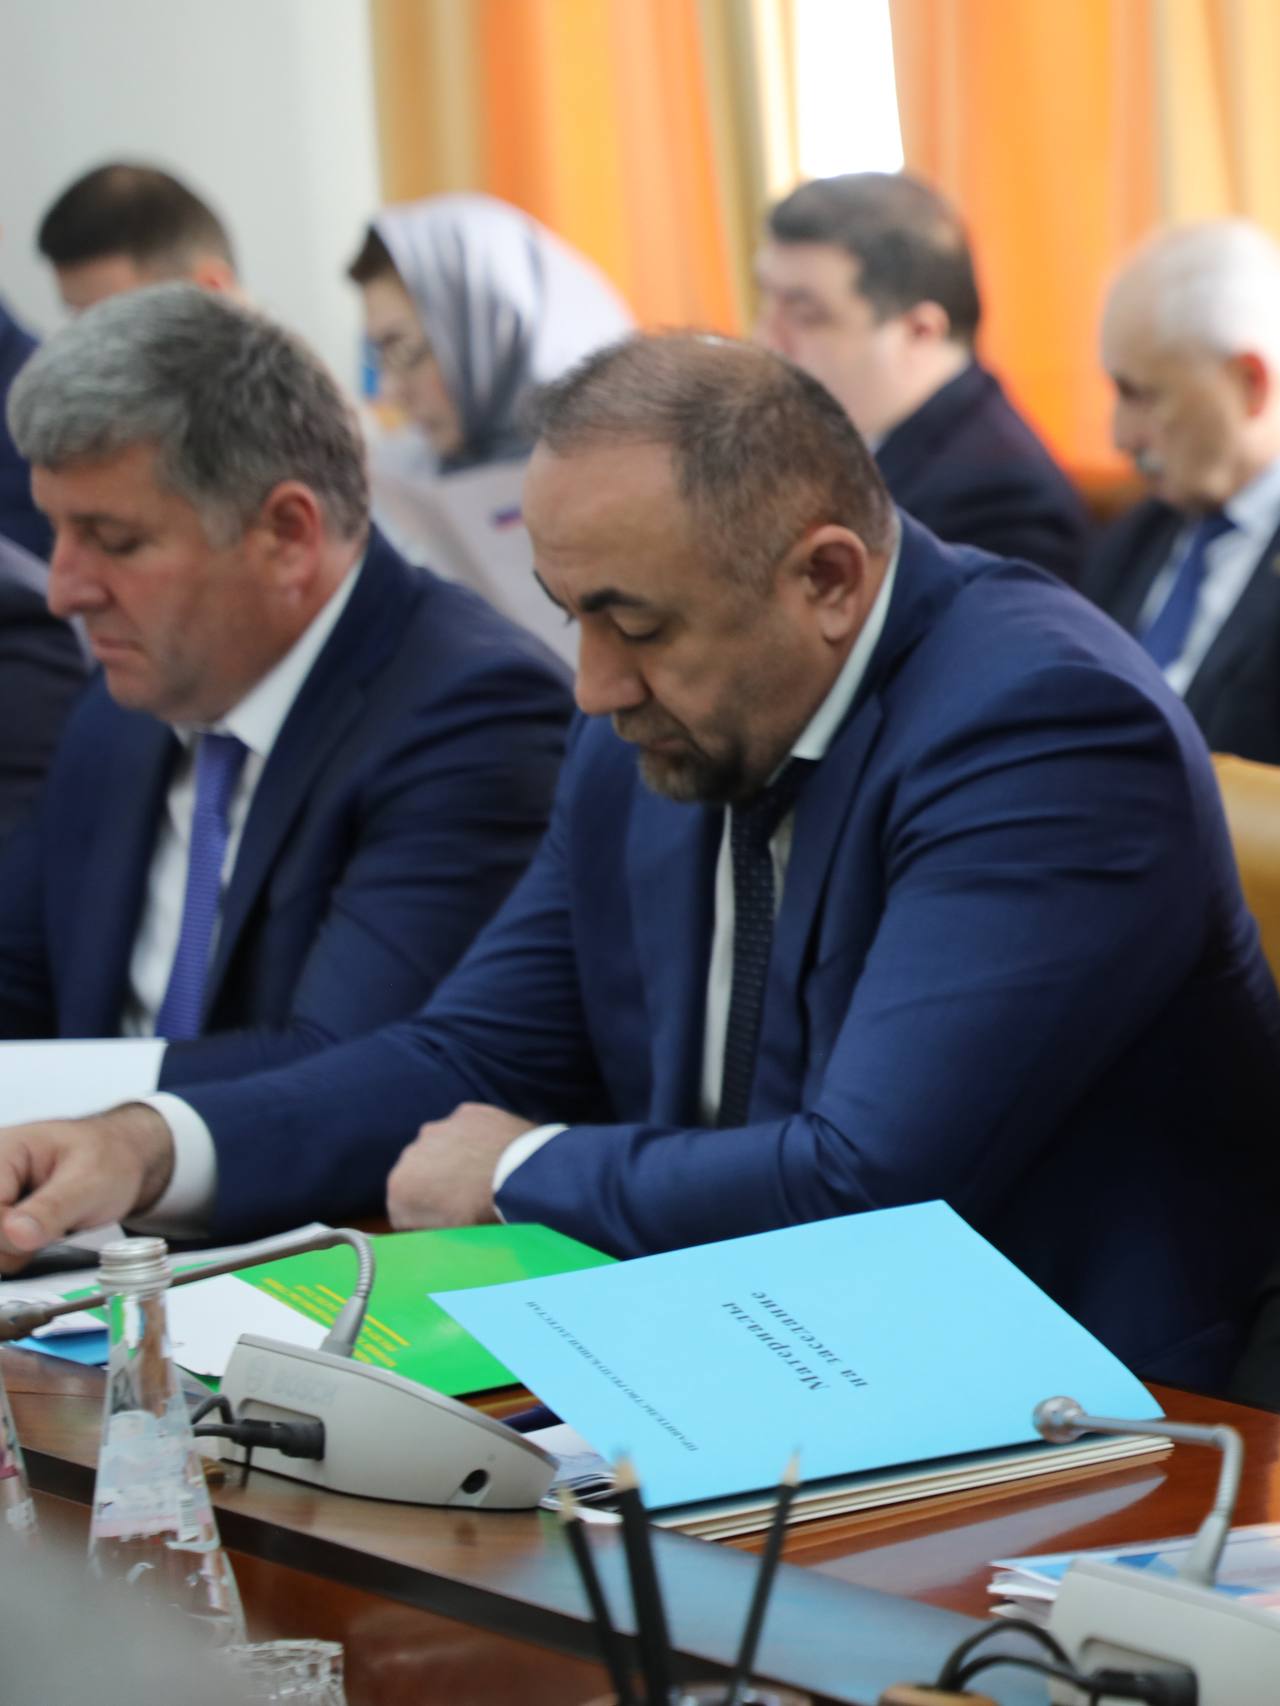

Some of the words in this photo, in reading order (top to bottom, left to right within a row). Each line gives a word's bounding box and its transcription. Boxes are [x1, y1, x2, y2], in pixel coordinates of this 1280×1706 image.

[720, 1302, 830, 1390] Материалы
[751, 1292, 843, 1364] заседание
[839, 1369, 869, 1387] на
